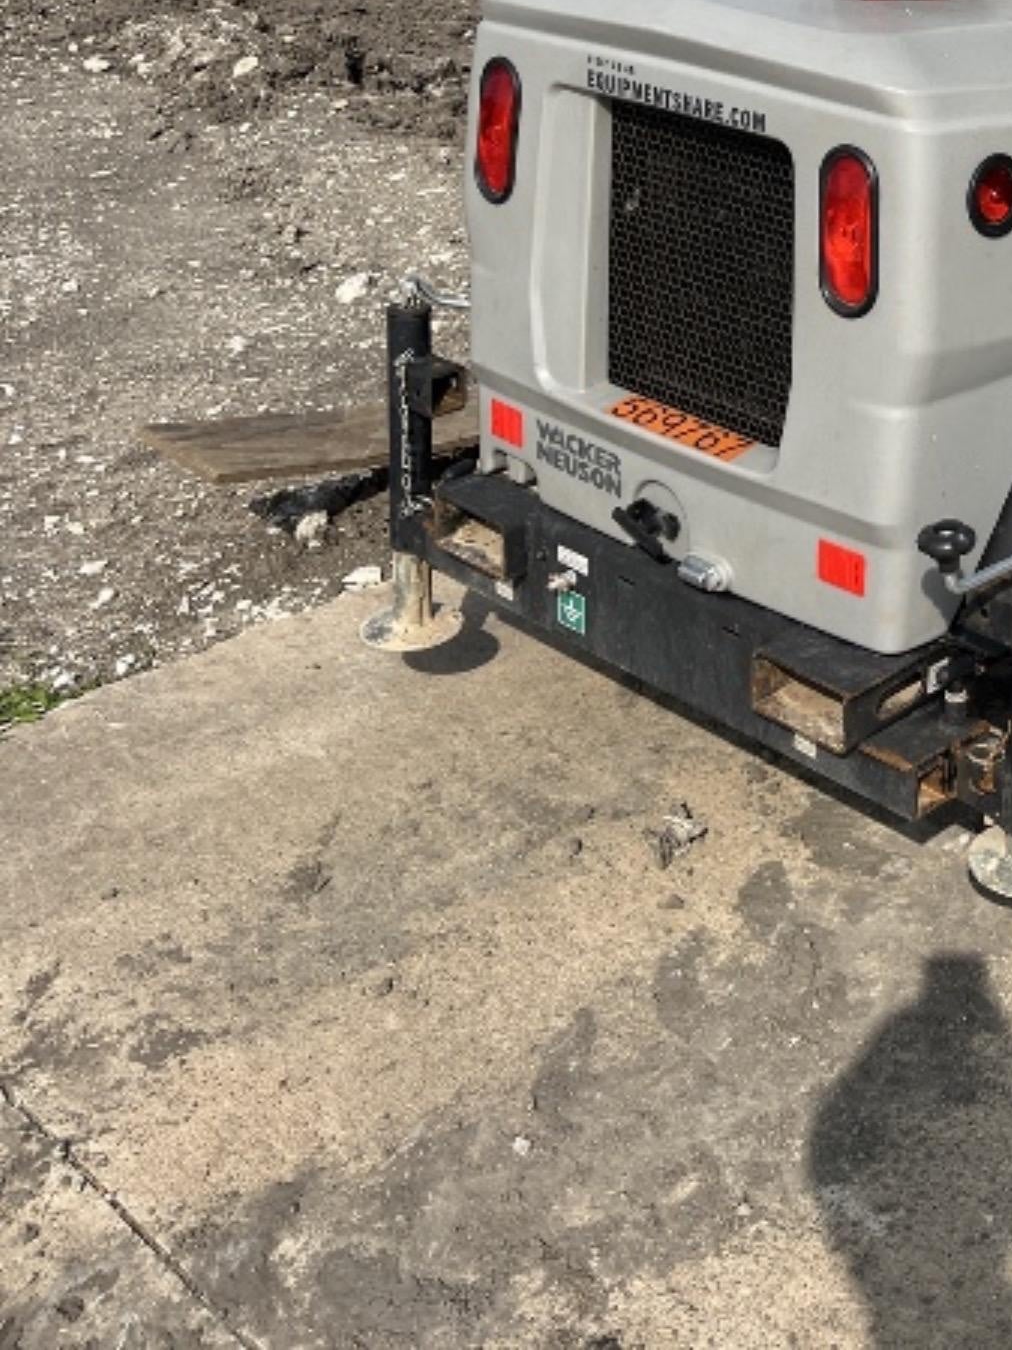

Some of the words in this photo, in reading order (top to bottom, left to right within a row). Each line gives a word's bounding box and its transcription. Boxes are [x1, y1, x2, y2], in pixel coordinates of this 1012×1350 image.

[587, 68, 767, 134] EQUIPMENTSHARE.COM
[536, 417, 621, 473] WACKER
[611, 397, 756, 457] 569767
[536, 440, 622, 498] NEUSON
